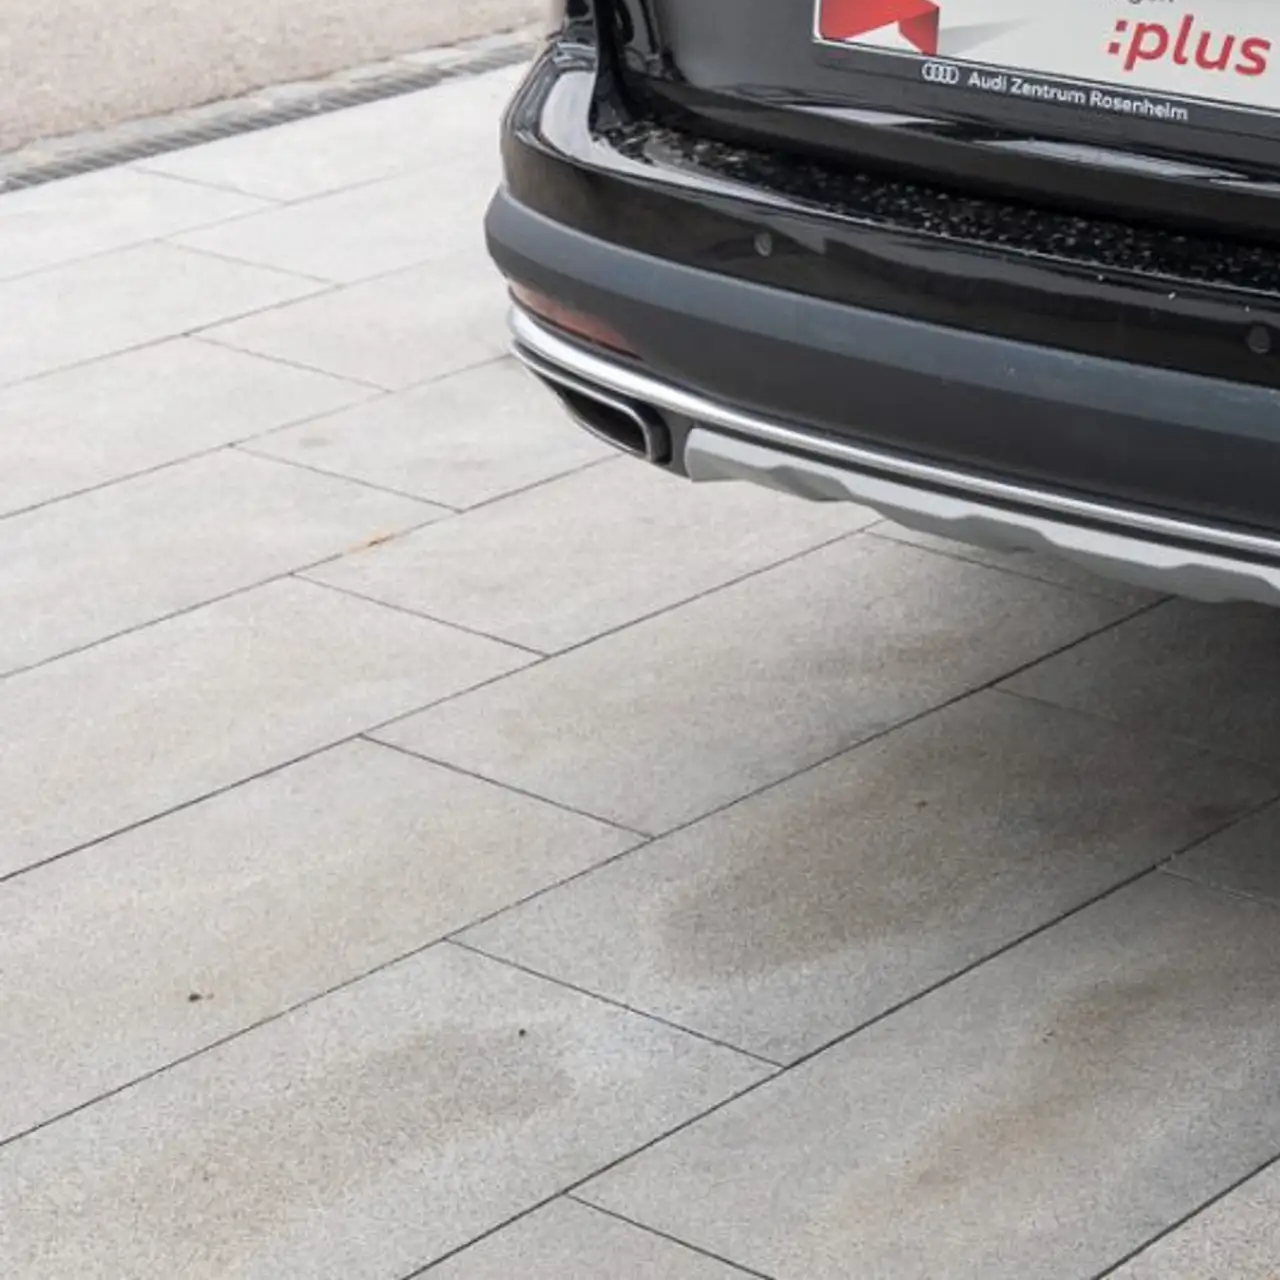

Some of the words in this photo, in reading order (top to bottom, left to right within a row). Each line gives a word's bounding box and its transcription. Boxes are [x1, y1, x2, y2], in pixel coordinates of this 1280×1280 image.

[1107, 14, 1271, 76] :plus
[967, 71, 1007, 91] Audi
[1010, 77, 1086, 104] Zentrum
[1089, 90, 1188, 120] Rosenheim
